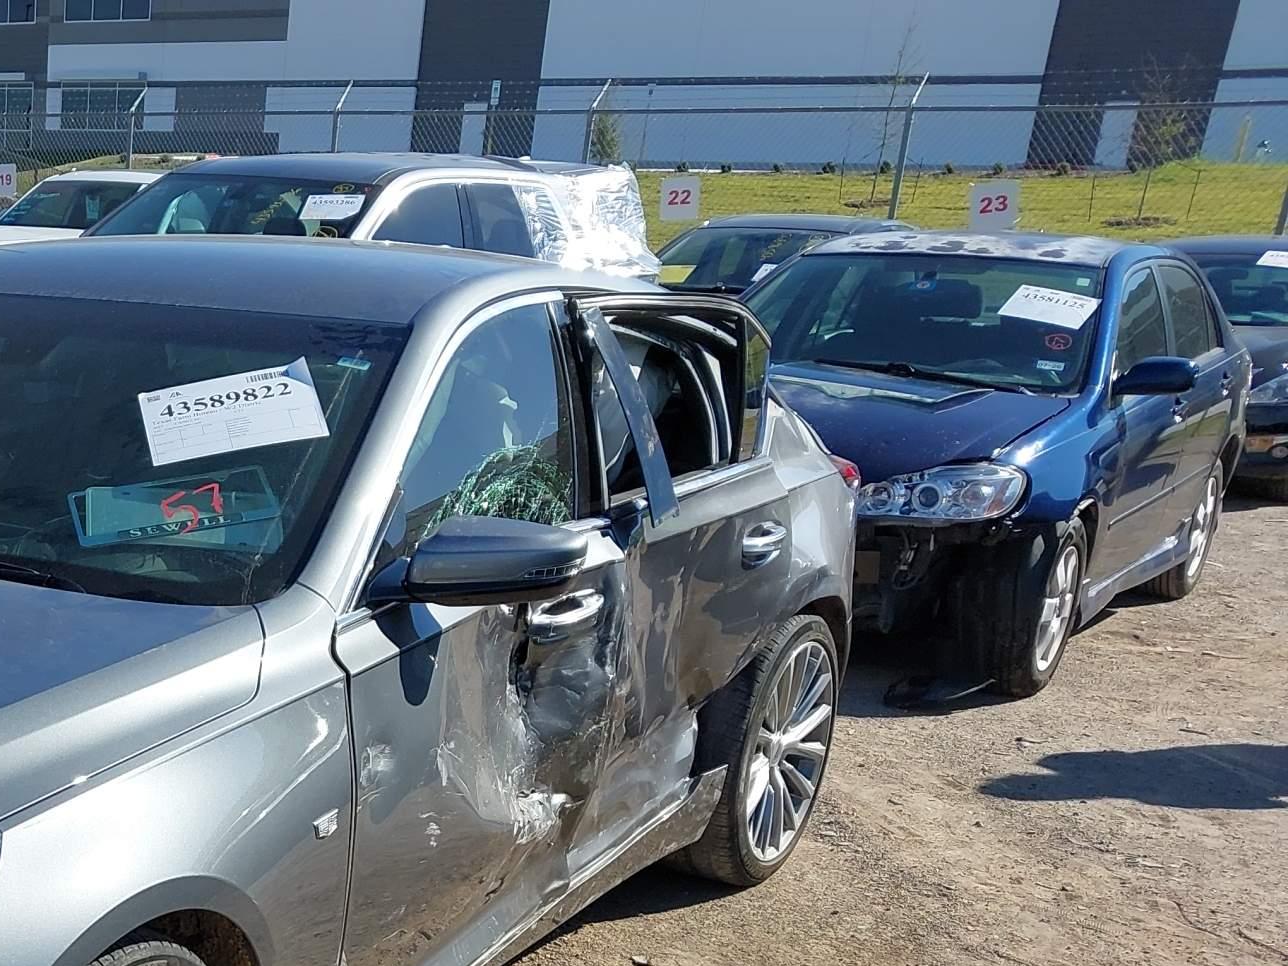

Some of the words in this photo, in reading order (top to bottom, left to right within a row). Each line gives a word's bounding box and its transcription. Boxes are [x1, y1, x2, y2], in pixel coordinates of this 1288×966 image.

[0, 173, 12, 186] 19
[667, 189, 692, 206] 22
[979, 194, 1009, 214] 23
[1022, 292, 1087, 310] 43581125
[159, 382, 292, 418] 43589822
[160, 483, 223, 536] 57
